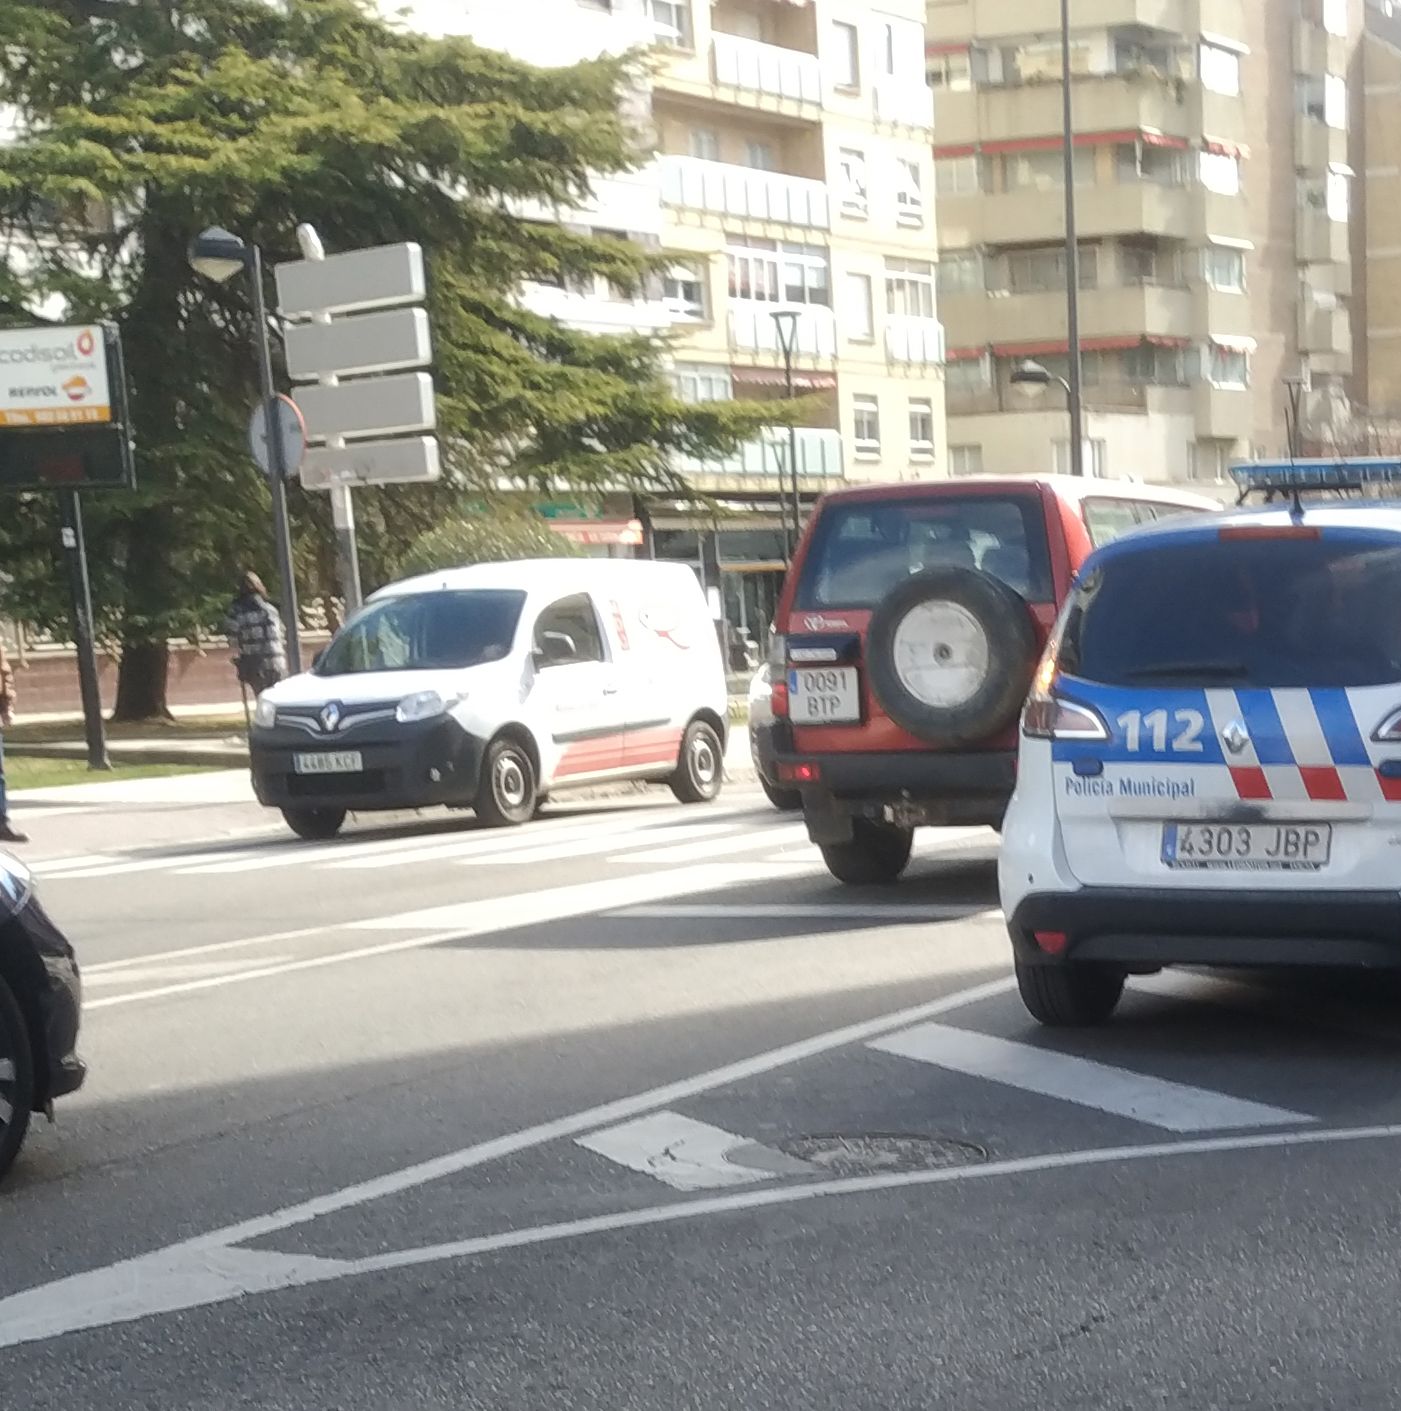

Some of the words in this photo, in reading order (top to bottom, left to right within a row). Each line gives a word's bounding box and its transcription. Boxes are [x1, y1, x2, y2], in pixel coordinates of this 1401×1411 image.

[803, 672, 848, 692] 0091
[807, 695, 840, 716] BTP
[1117, 709, 1204, 752] 112
[1119, 777, 1195, 800] Municipal
[1180, 827, 1251, 858] 4303
[1265, 827, 1320, 858] JBP
